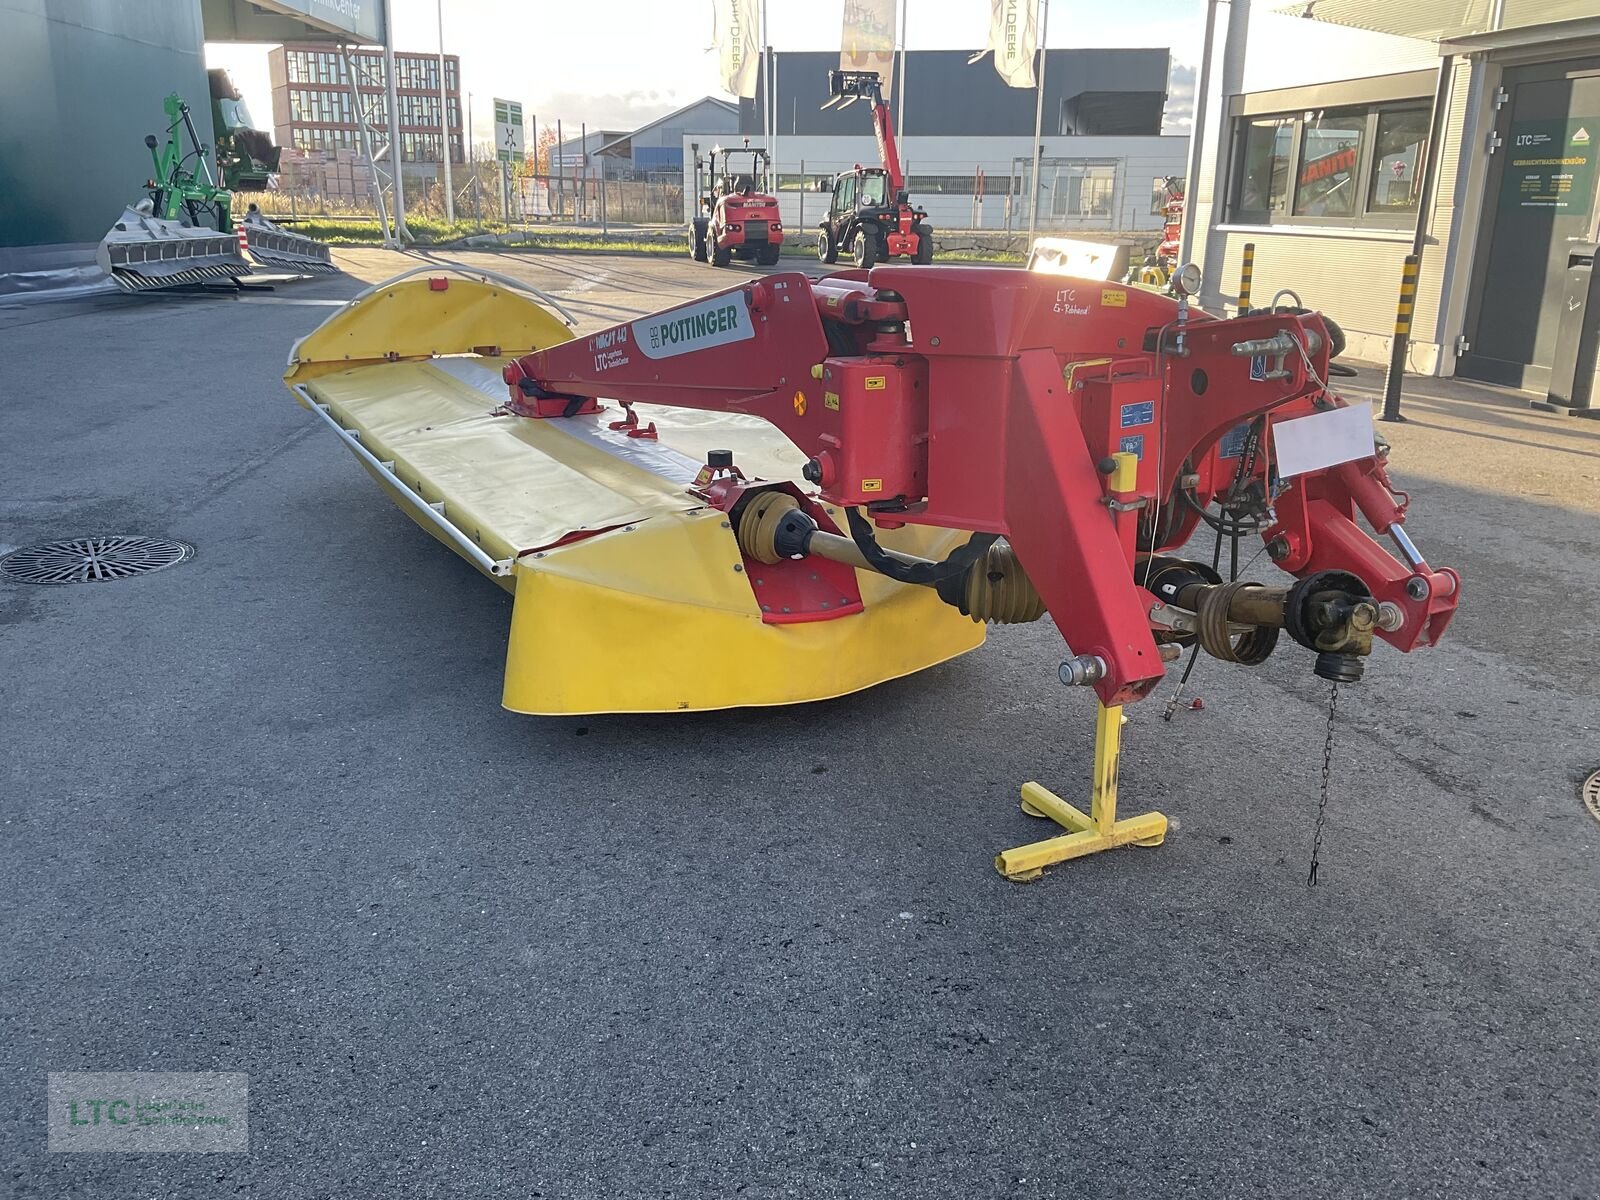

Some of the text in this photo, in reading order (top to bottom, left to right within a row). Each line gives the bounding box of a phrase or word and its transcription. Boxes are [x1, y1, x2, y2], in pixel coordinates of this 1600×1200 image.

[1516, 134, 1532, 146] LTC
[1056, 289, 1076, 302] LTC
[660, 304, 738, 346] PÖTTINGER
[594, 353, 608, 372] LTC
